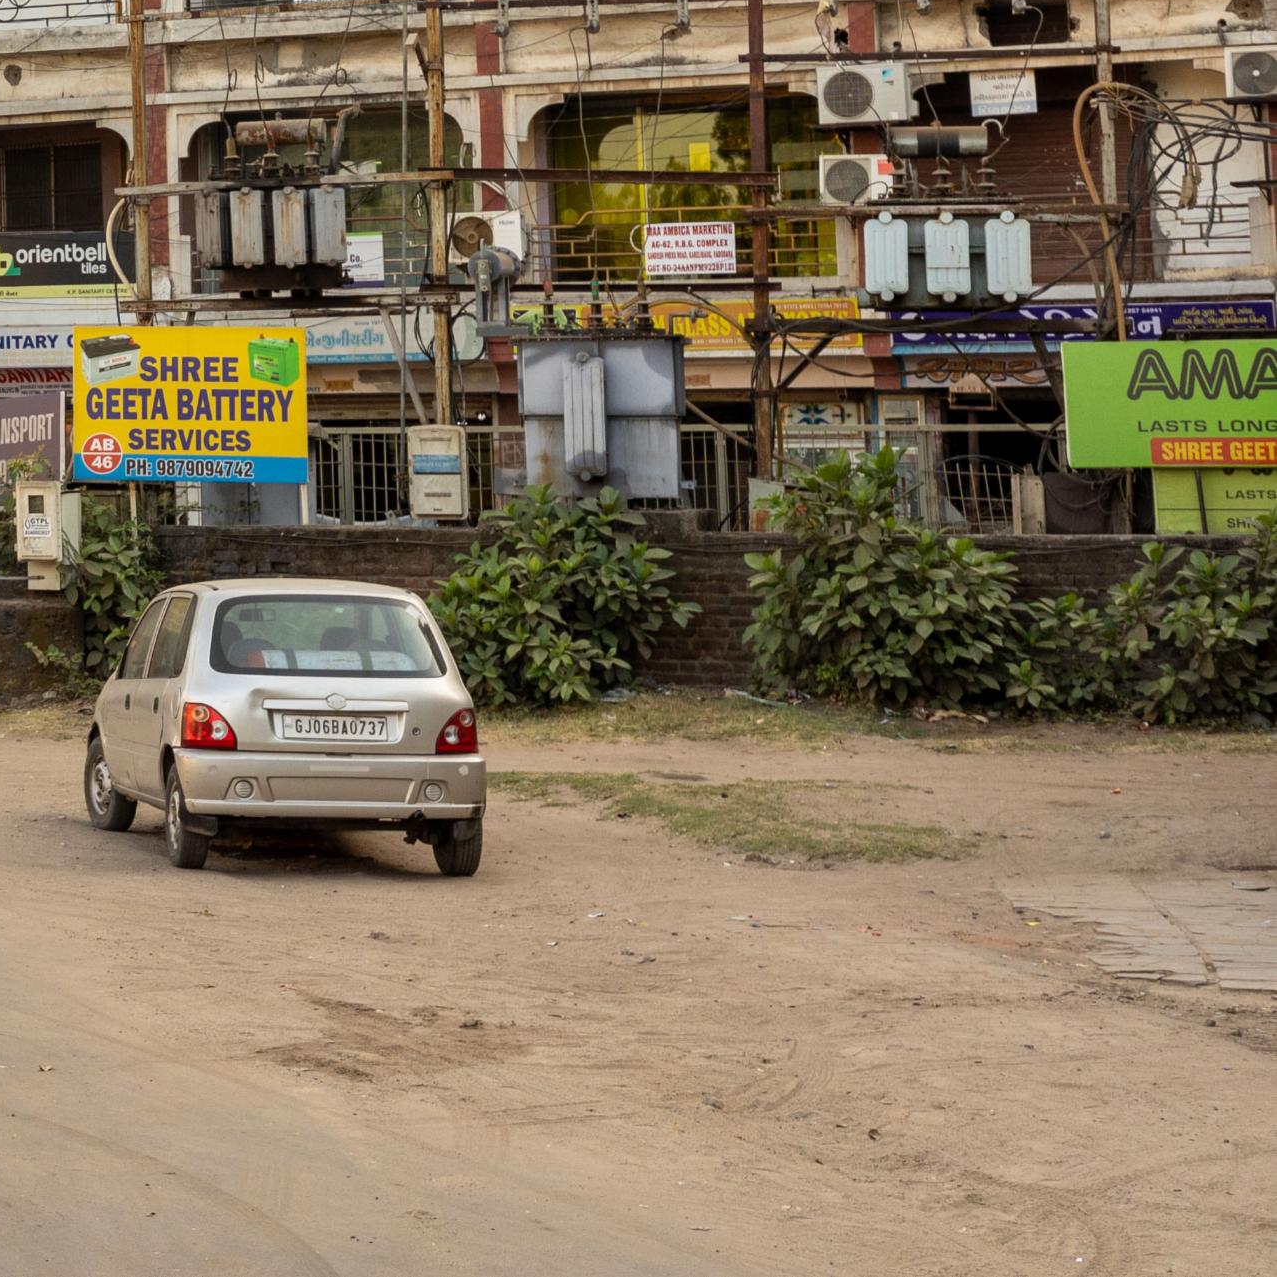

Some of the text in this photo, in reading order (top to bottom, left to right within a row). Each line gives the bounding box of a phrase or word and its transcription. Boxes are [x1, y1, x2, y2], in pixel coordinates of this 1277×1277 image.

[663, 225, 690, 236] AMBICA
[692, 224, 733, 235] MARKETING
[696, 239, 728, 247] COMPLEX
[15, 242, 107, 264] orientbell
[81, 263, 107, 274] tiles
[139, 356, 239, 383] SHREE
[86, 388, 293, 422] GEETA BATTERY
[1137, 420, 1207, 433] LASTS
[90, 438, 115, 451] AB
[128, 428, 251, 452] SERVICES
[1161, 441, 1224, 461] SHREE
[91, 455, 113, 469] 46
[125, 459, 254, 477] PH: 9879094742
[1225, 490, 1277, 500] LASTS
[30, 517, 49, 525] GTPL
[295, 719, 385, 736] GJ06BA0737
